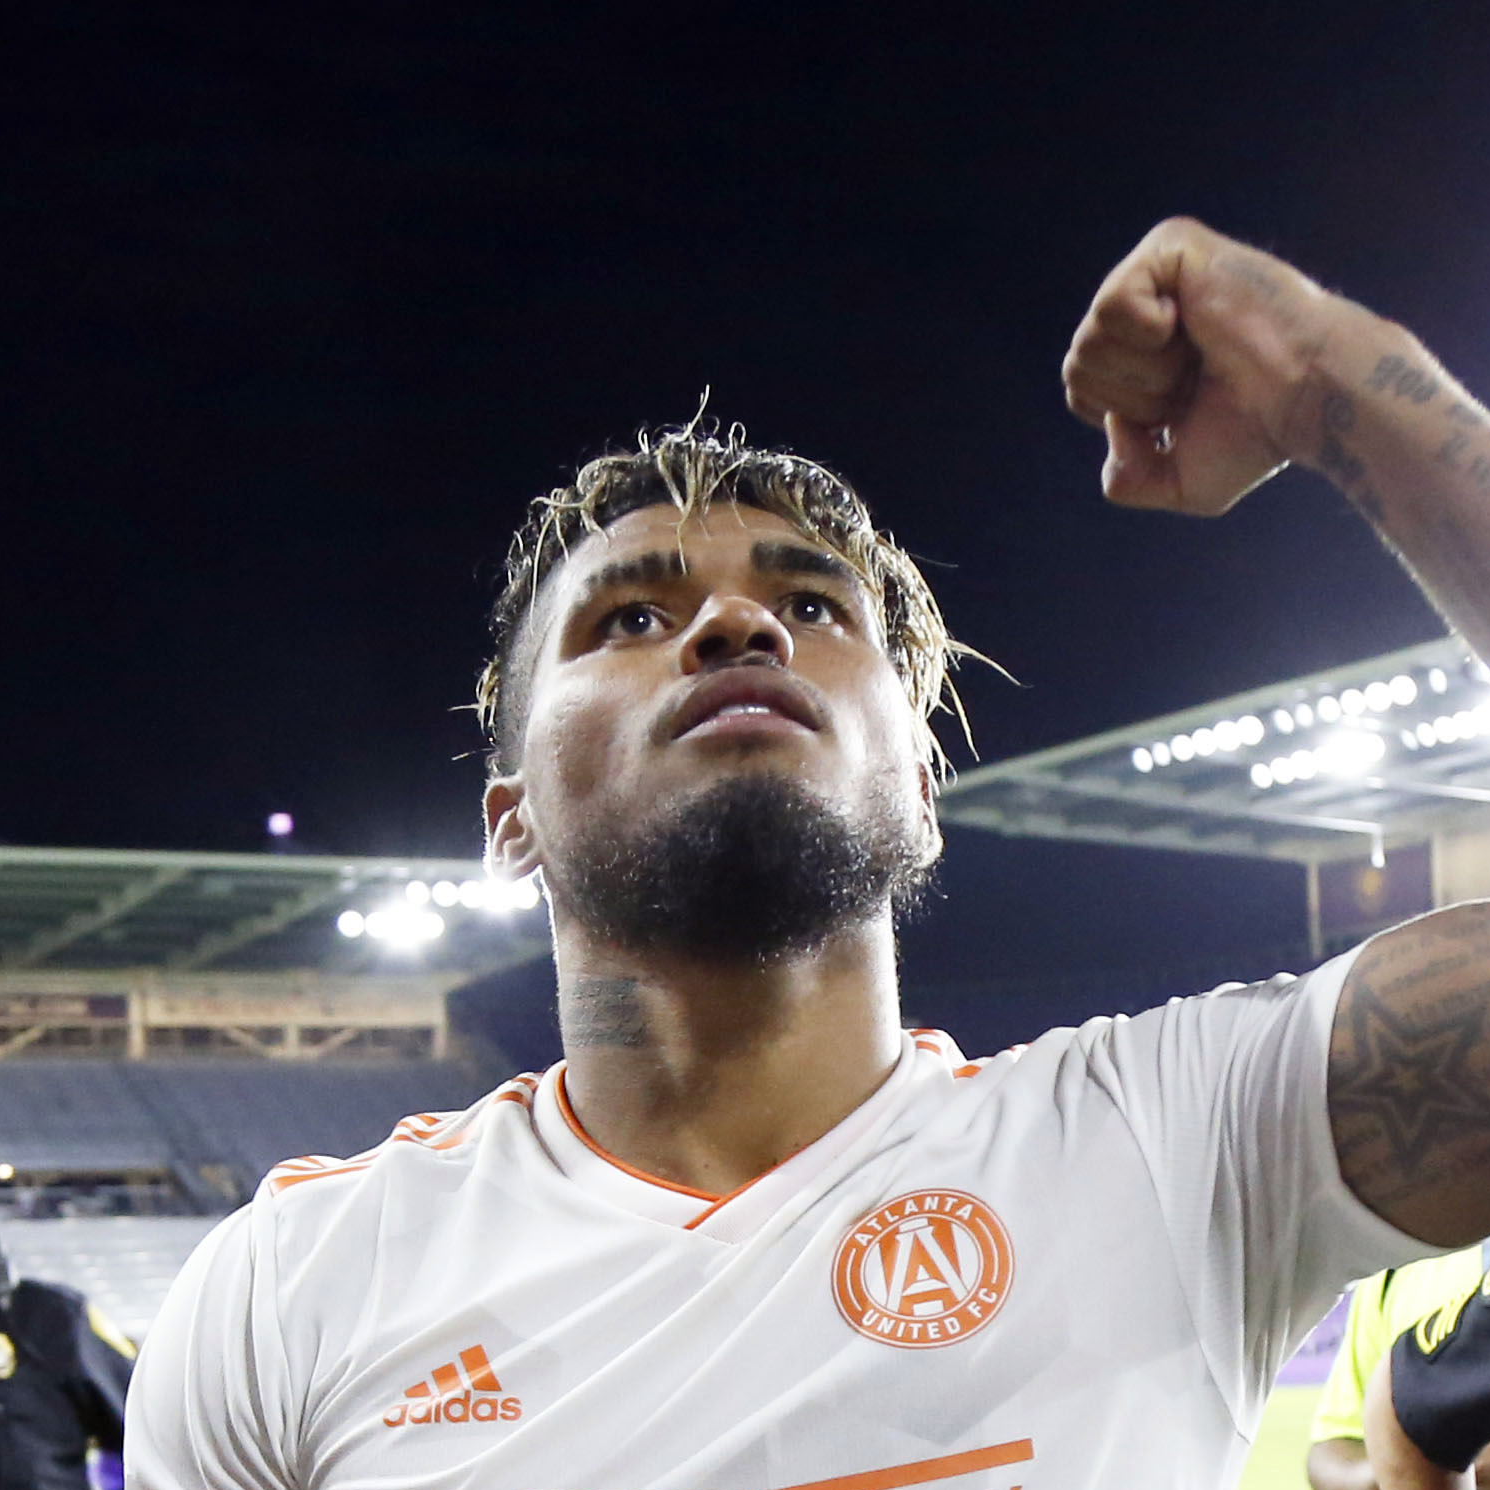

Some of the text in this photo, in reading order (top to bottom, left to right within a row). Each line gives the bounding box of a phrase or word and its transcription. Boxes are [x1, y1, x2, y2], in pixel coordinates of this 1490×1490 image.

[853, 1195, 974, 1247] ATLANTA
[861, 1286, 999, 1340] UNITED FC
[382, 1388, 523, 1429] adidas
